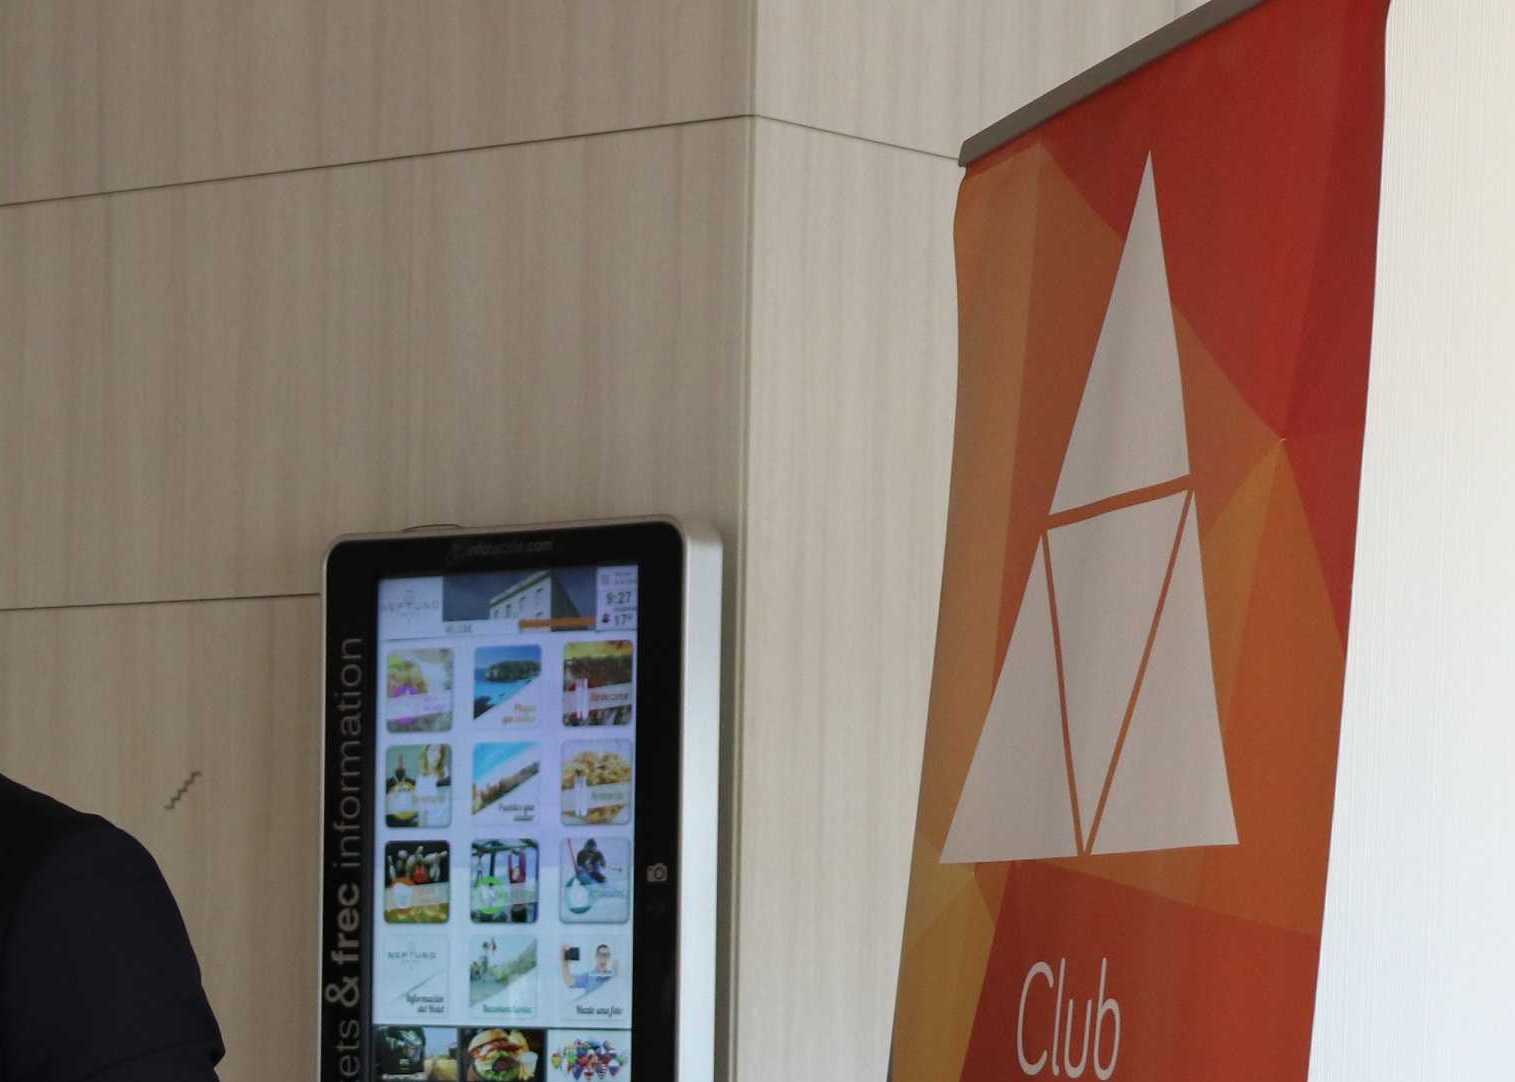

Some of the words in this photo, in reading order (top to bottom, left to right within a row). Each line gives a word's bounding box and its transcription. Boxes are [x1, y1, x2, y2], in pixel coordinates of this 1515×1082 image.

[332, 637, 363, 869] information
[325, 974, 361, 1009] &
[1016, 957, 1122, 1081] Club
